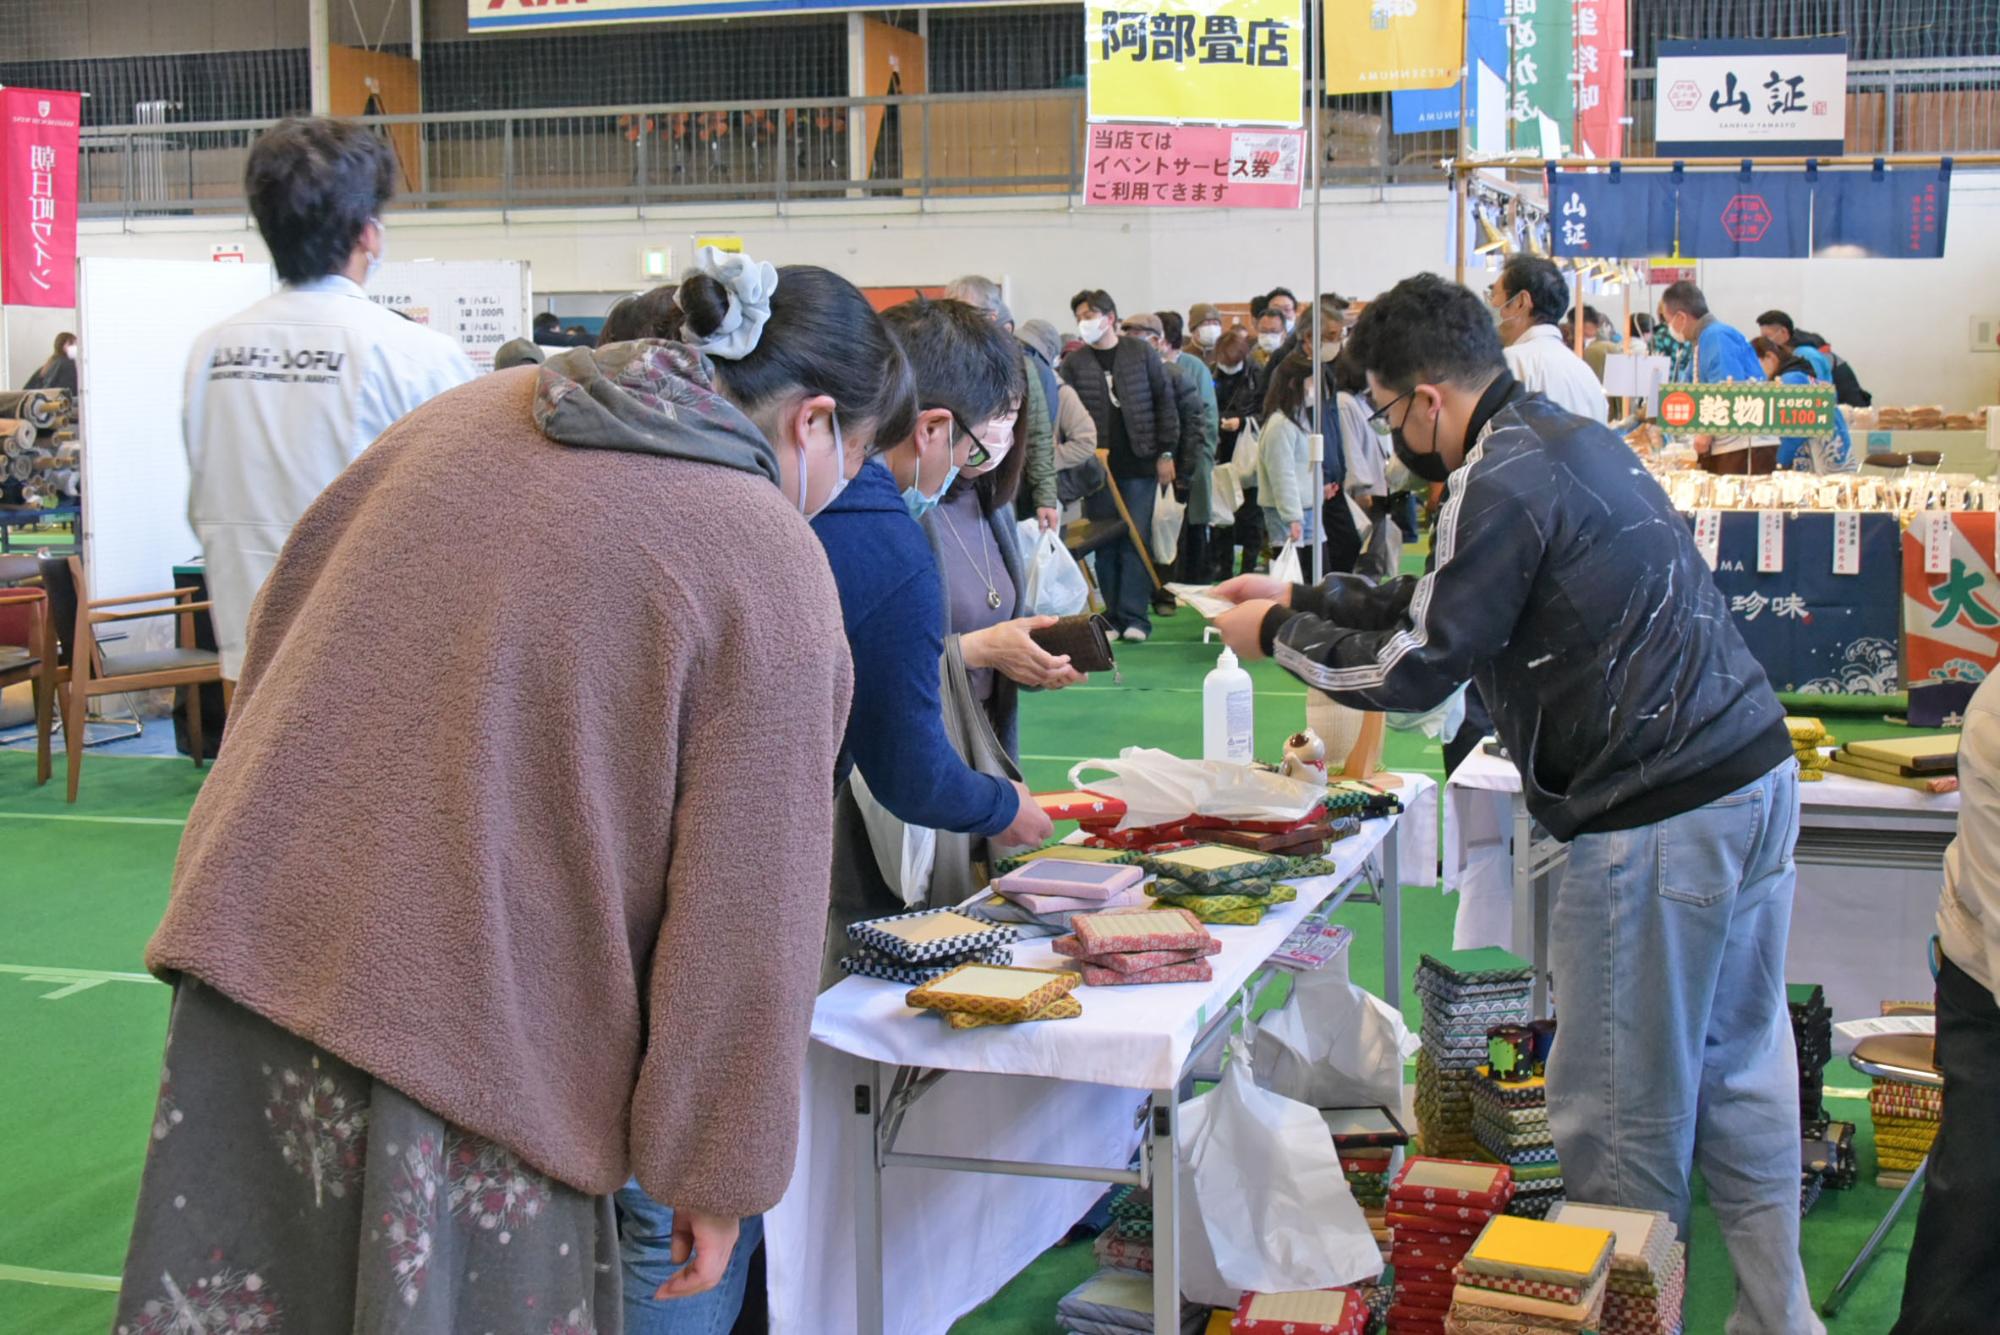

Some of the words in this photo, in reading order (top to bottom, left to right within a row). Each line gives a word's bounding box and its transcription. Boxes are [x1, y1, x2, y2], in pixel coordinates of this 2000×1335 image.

[1101, 10, 1290, 67] 阿部畳店
[1709, 70, 1809, 116] 山証
[1094, 129, 1173, 150] 当店では
[1093, 155, 1271, 179] イベントサービス券
[1092, 181, 1230, 203] ご利用できます
[1562, 191, 1587, 246] 山証
[1699, 395, 1766, 426] 乾物
[1731, 590, 1809, 620] 珍味
[1931, 558, 1999, 629] 大
